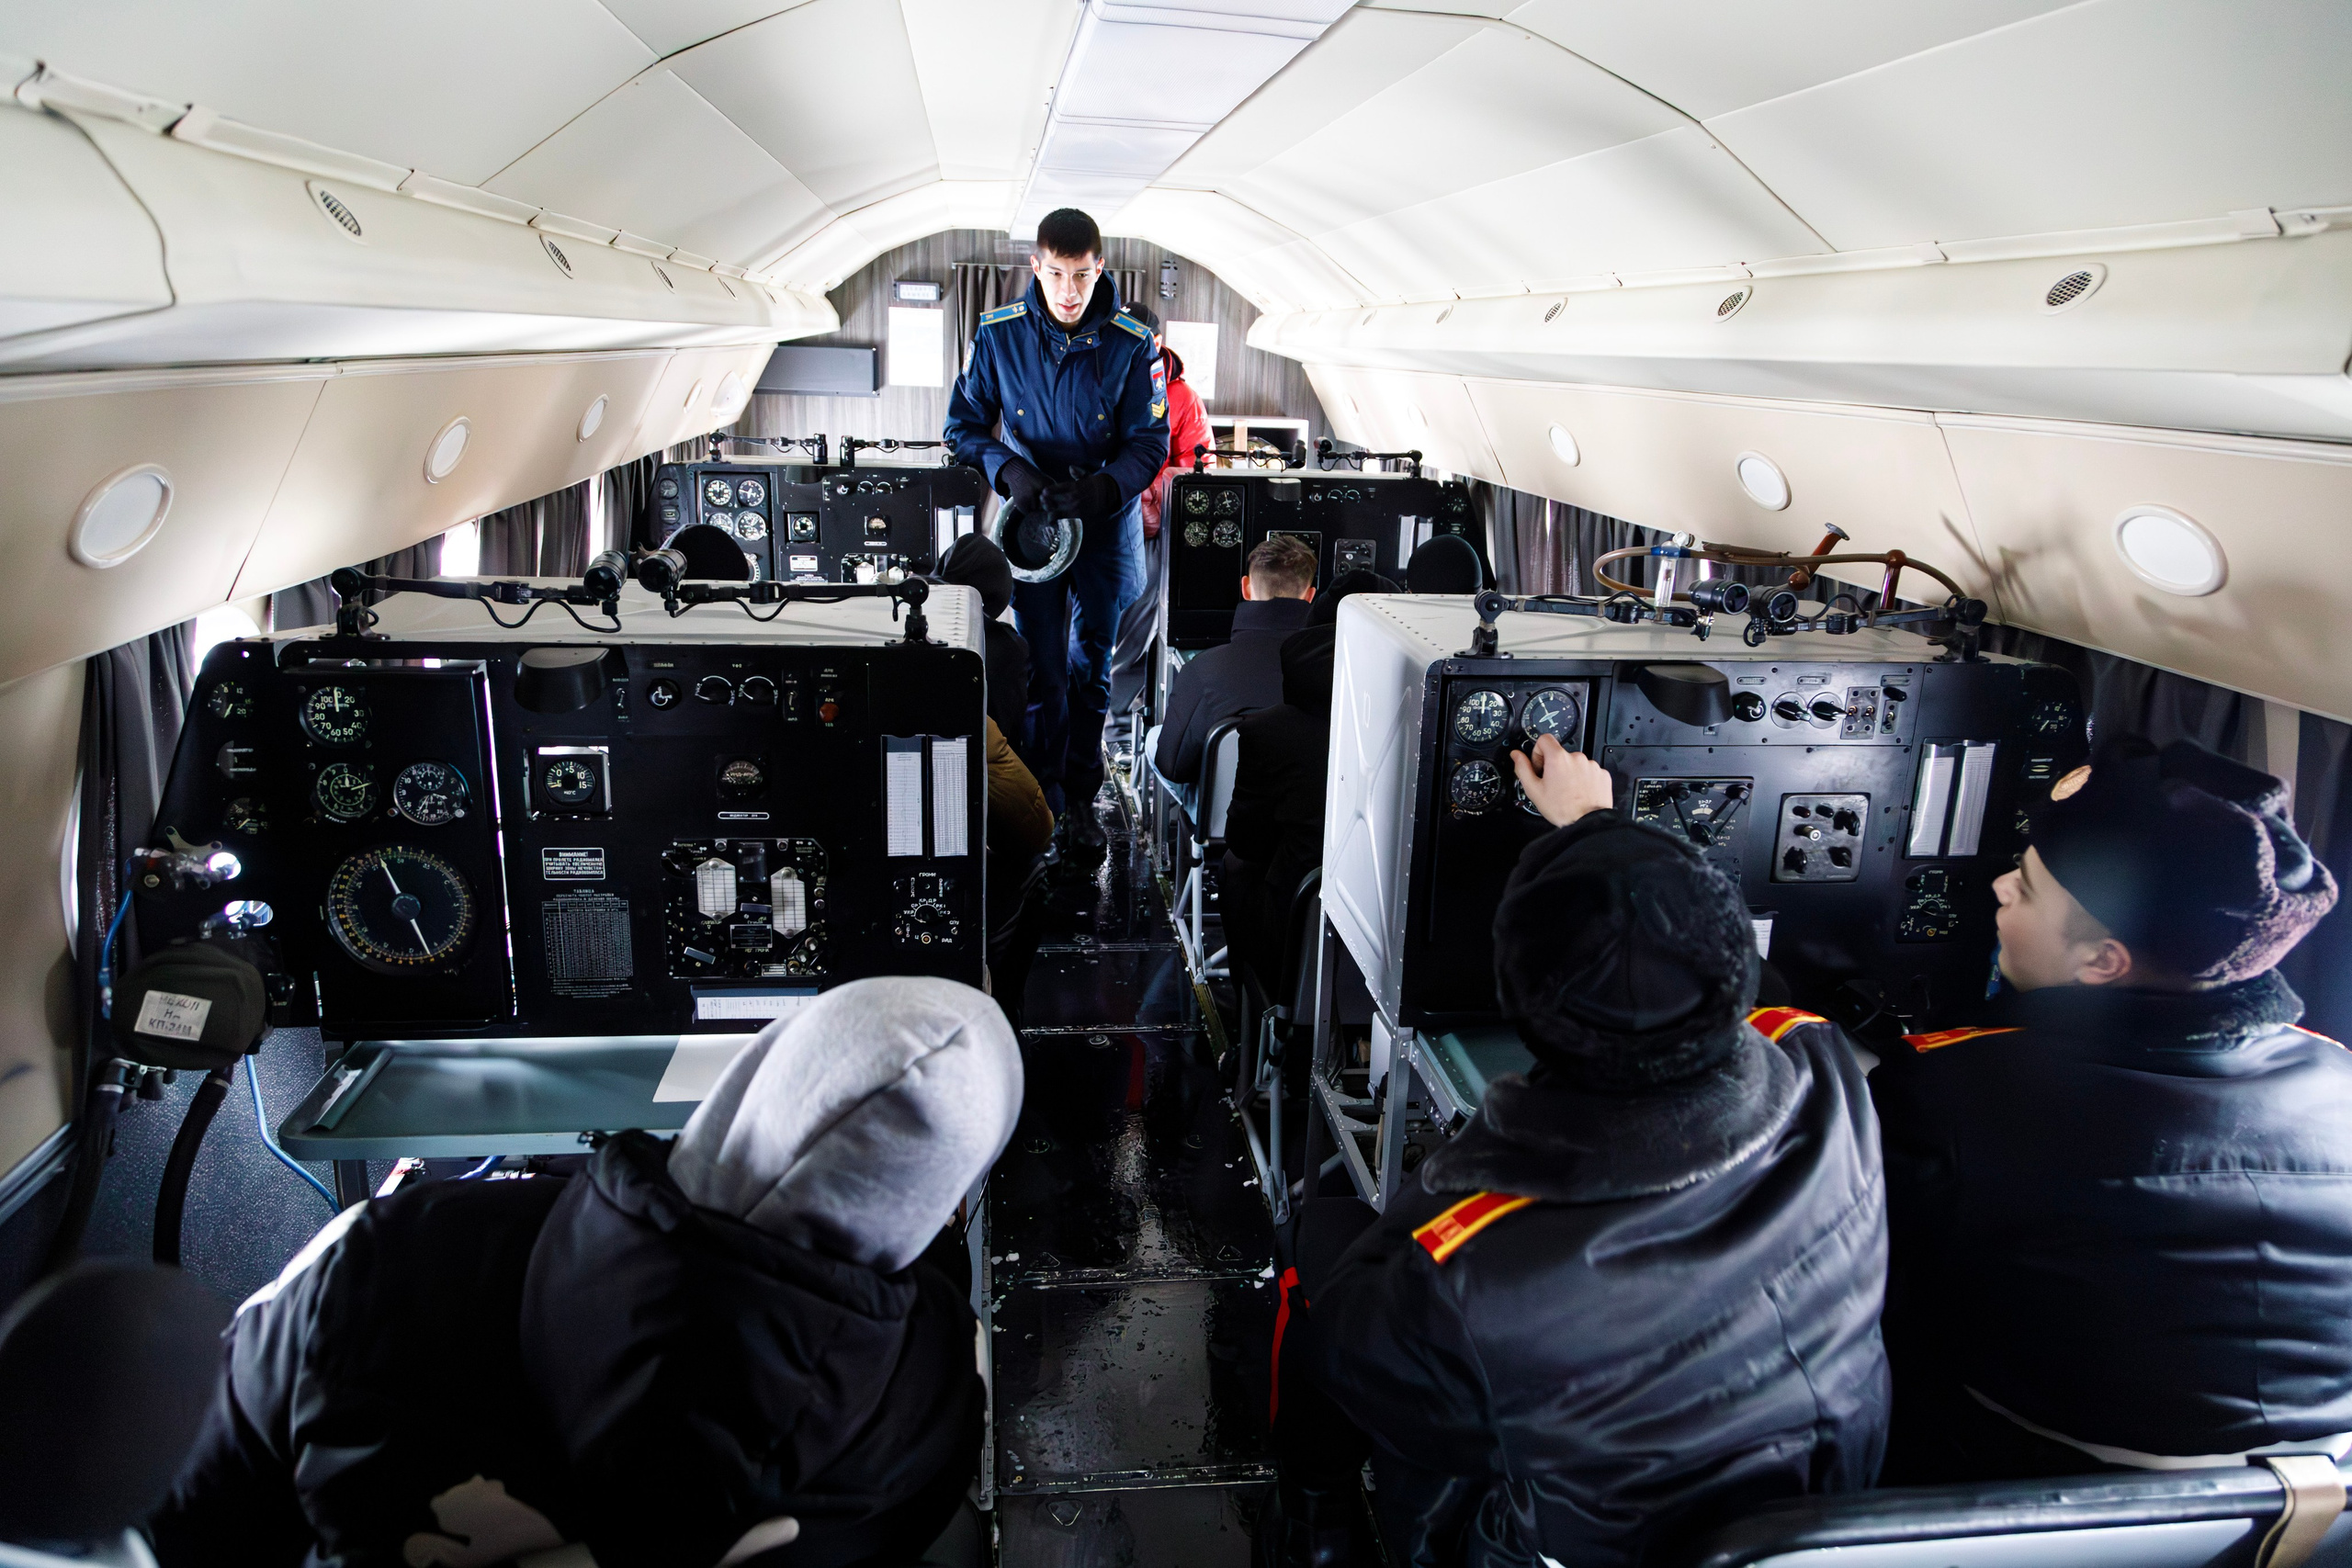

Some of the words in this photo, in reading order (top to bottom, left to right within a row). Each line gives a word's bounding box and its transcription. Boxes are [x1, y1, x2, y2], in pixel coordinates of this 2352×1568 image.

[331, 728, 341, 737] 60
[343, 728, 354, 736] 50
[556, 769, 562, 777] 0
[565, 765, 575, 773] +5
[577, 772, 585, 780] 10
[579, 781, 587, 789] 15
